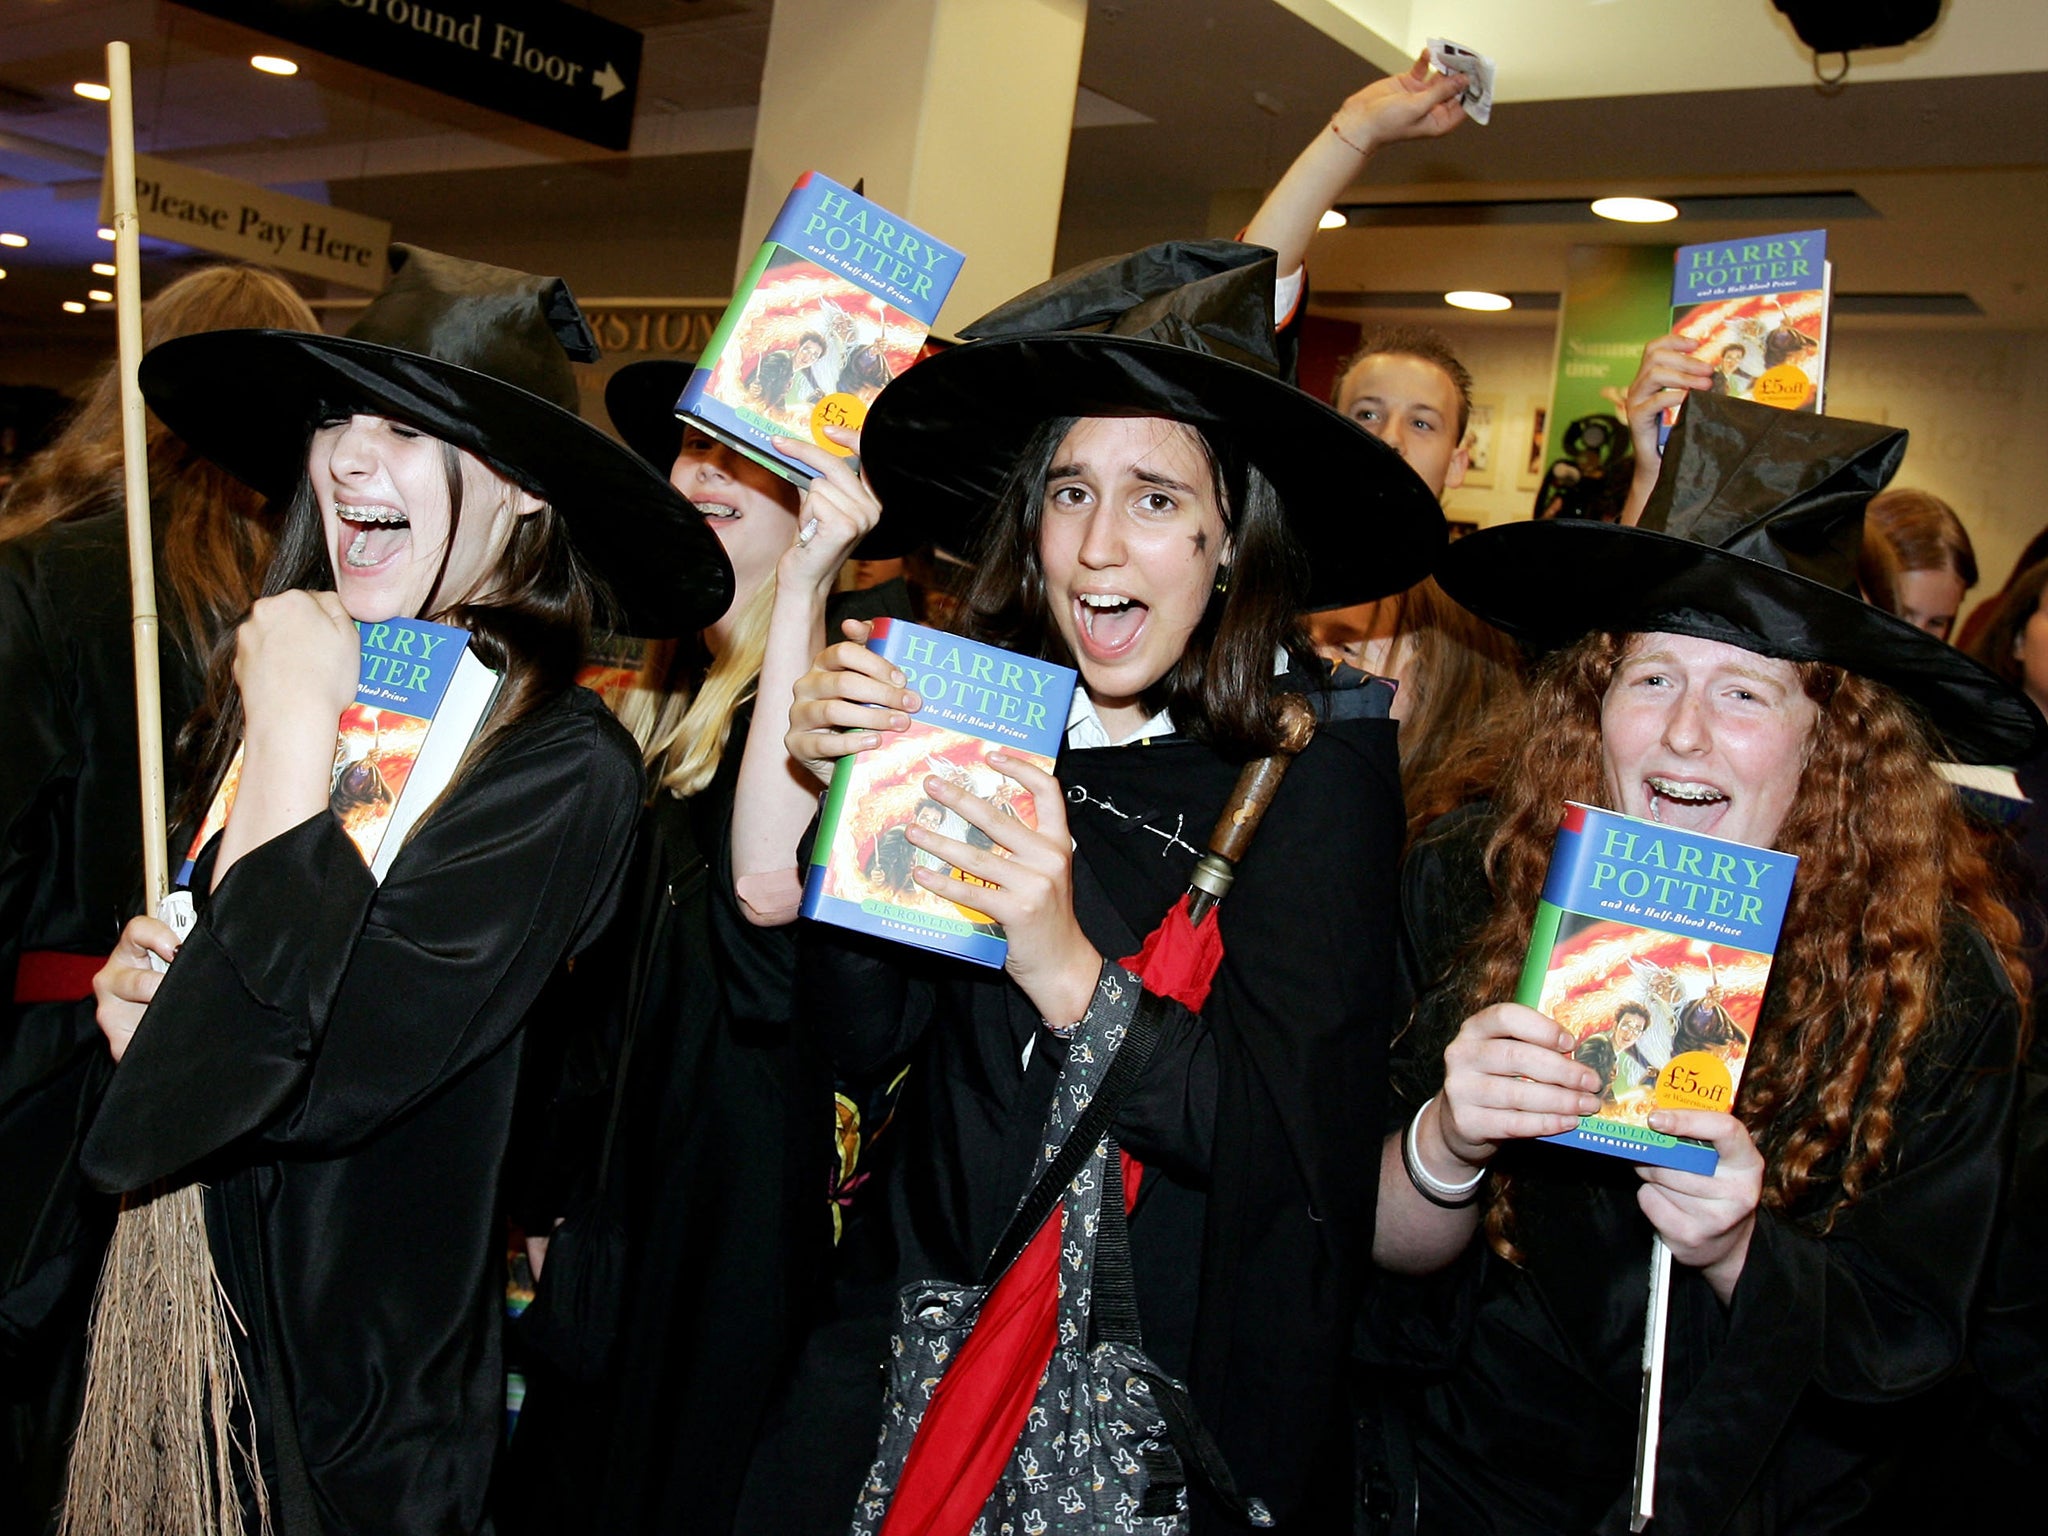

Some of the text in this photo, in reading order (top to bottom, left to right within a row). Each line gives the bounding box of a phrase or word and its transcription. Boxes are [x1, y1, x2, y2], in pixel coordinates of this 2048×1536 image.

[341, 0, 583, 86] round Floor
[135, 177, 373, 267] Please Pay Here
[817, 189, 948, 272] HARRY
[803, 213, 933, 301] POTTER
[1692, 238, 1810, 269] HARRY
[807, 244, 913, 304] and the Half-Blood Prince
[1688, 259, 1810, 289] POTTER
[1728, 282, 1770, 293] Half-Blood
[1772, 280, 1797, 288] Prince
[818, 402, 860, 431] £5
[354, 620, 447, 661] RRY
[360, 652, 431, 693] TER
[903, 634, 1056, 698] HARRY
[381, 689, 408, 703] Prince
[897, 665, 1046, 731] POTTER
[924, 704, 1029, 740] the Half-Blood Prince
[1600, 828, 1774, 890] HARRY
[1588, 861, 1763, 926] POTTER
[893, 907, 964, 934] ROWLING
[1600, 899, 1742, 937] and the Half-Blood Prince
[1663, 1066, 1729, 1103] £5off
[1578, 1132, 1649, 1153] BLOOMSBURY
[1596, 1120, 1667, 1144] ROWLING
